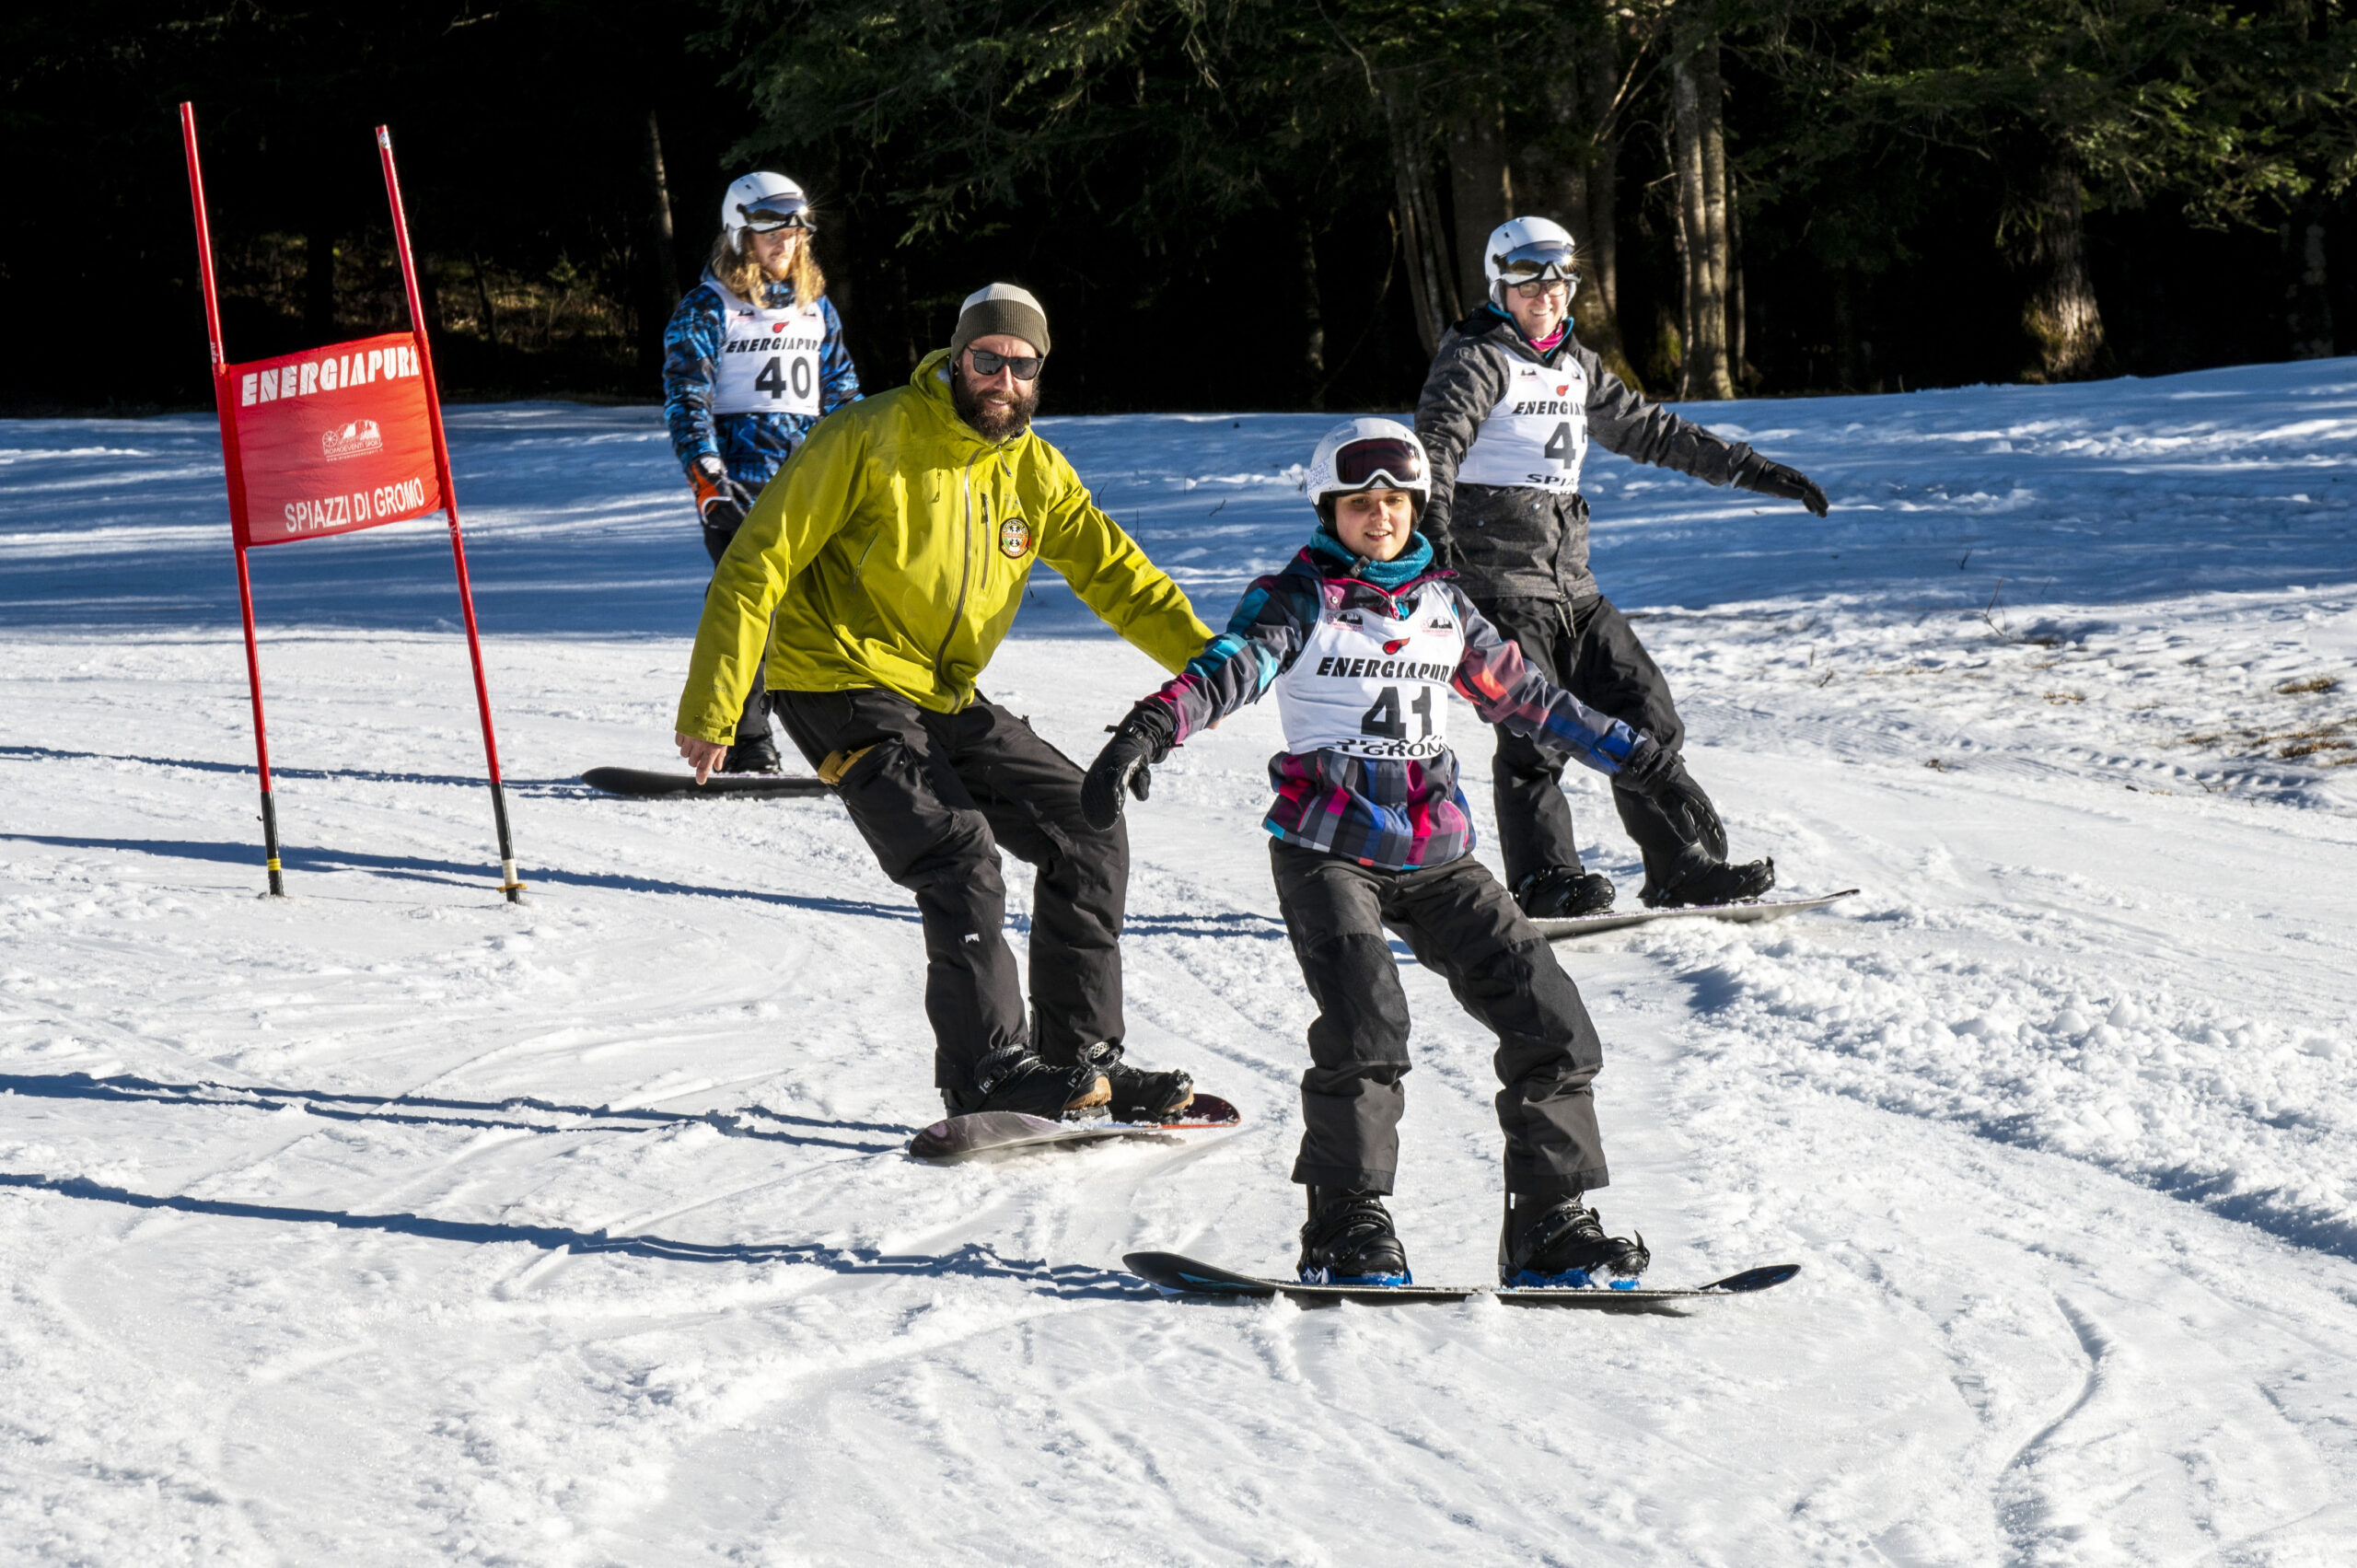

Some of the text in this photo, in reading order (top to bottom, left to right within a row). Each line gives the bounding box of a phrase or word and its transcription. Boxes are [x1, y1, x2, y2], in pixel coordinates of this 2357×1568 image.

[726, 337, 820, 354] ENERGIAPUR
[755, 356, 811, 400] 40
[284, 477, 424, 533] SPIAZZI DI GROMO
[1317, 656, 1455, 683] ENERGIAPUR
[1361, 686, 1433, 740] 41
[1363, 740, 1452, 758] GROM
